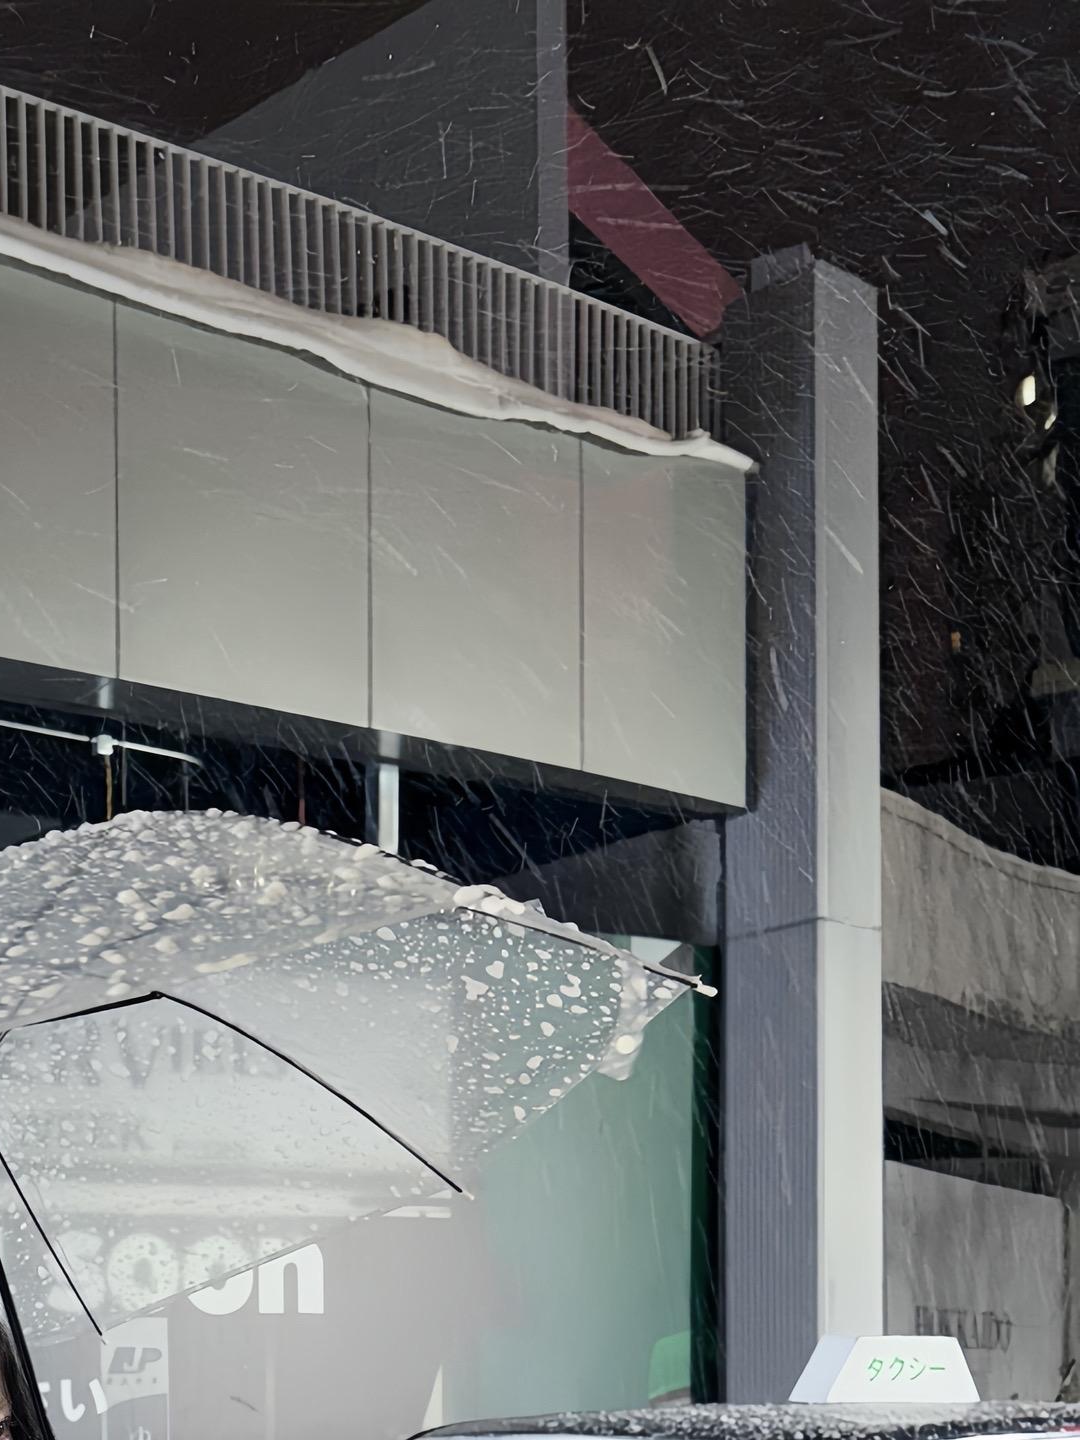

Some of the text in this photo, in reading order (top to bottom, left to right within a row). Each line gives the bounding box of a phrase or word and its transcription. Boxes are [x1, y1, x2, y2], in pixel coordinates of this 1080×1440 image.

[48, 1230, 324, 1315] soon
[867, 1356, 946, 1382] タクシー
